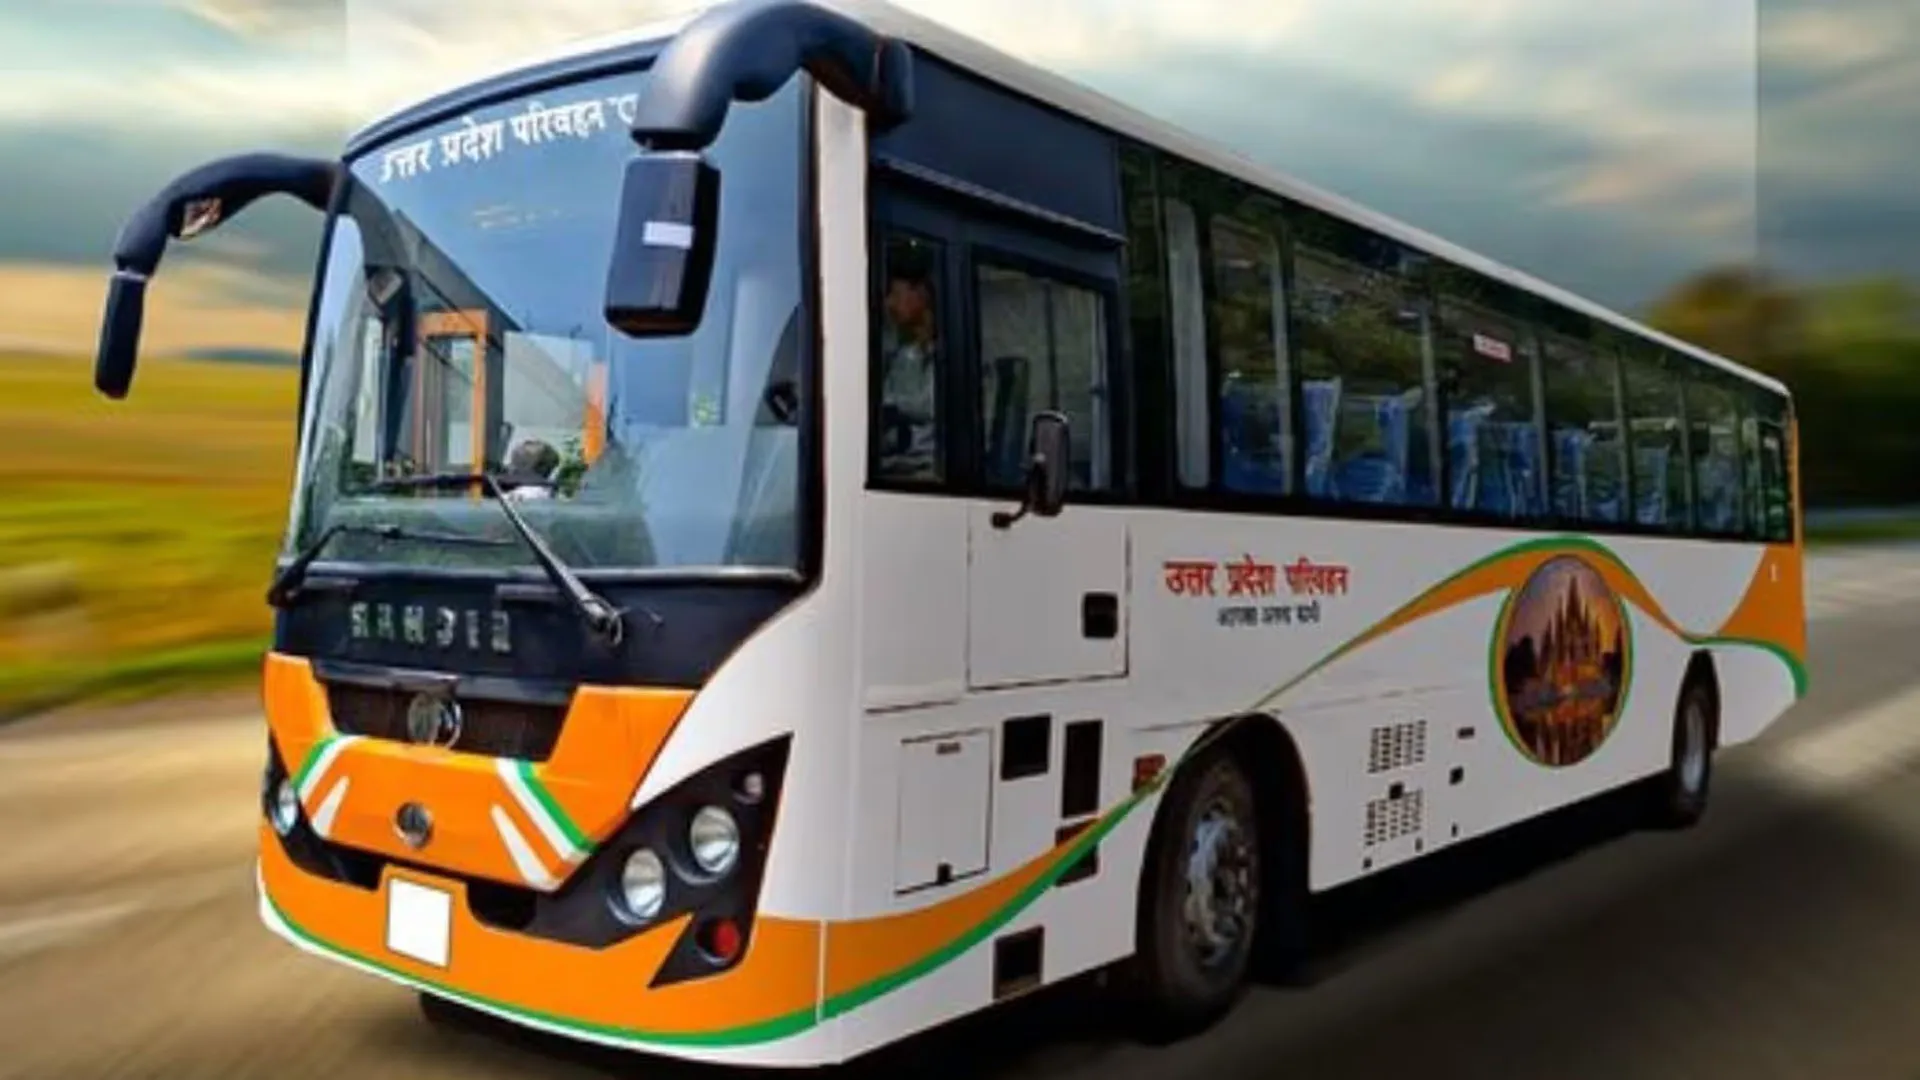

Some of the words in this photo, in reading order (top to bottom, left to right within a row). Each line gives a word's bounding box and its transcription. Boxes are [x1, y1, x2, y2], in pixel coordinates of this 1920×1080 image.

[379, 138, 433, 184] उत्तर
[440, 115, 504, 167] प्रदेश
[509, 101, 605, 145] परिवहन
[1163, 561, 1217, 597] उत्तर
[1225, 553, 1277, 598] प्रदेश
[1284, 556, 1349, 596] परिवहन
